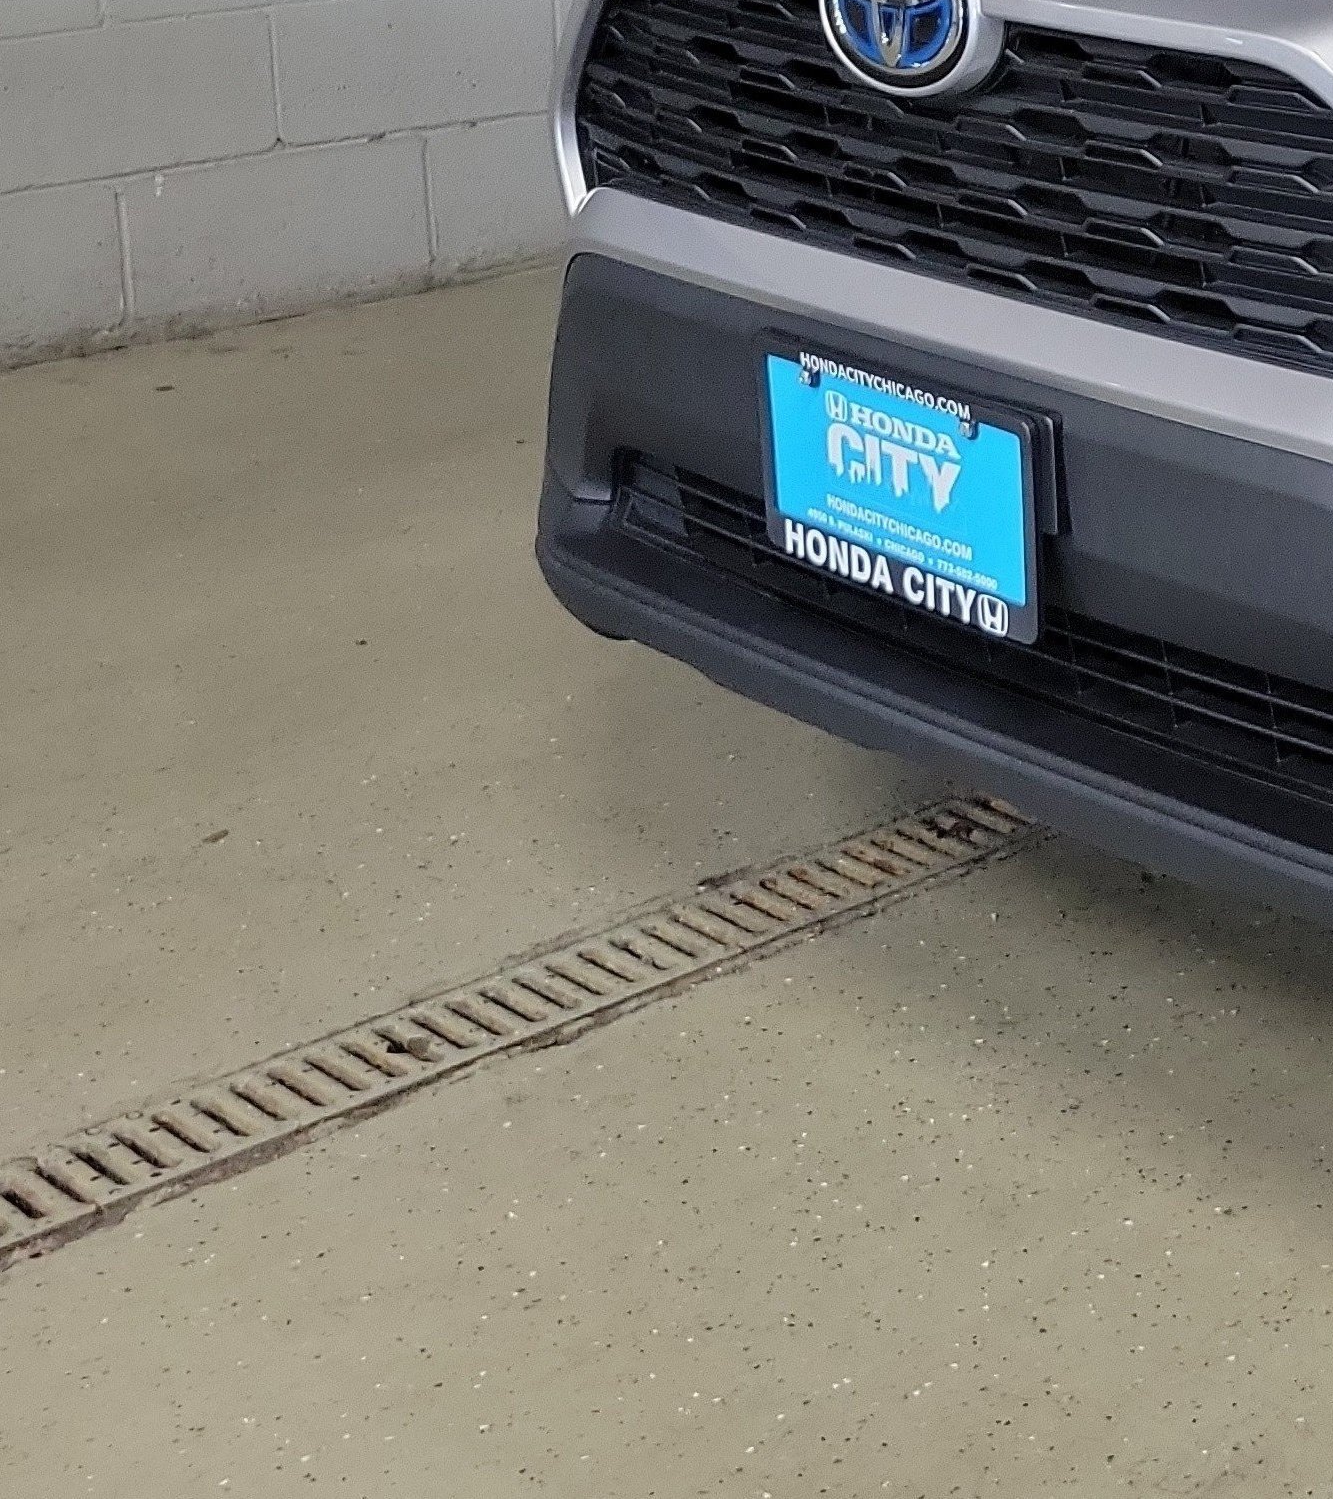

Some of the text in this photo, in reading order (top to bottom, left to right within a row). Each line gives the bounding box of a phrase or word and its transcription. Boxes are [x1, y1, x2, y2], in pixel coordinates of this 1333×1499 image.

[799, 351, 971, 420] HONDACITYCHICAGO.COM
[850, 402, 962, 461] HONDA
[827, 422, 962, 514] CITY
[825, 493, 973, 561] HONDACITYCHICAGO.COM
[784, 518, 979, 625] HONDA CITY
